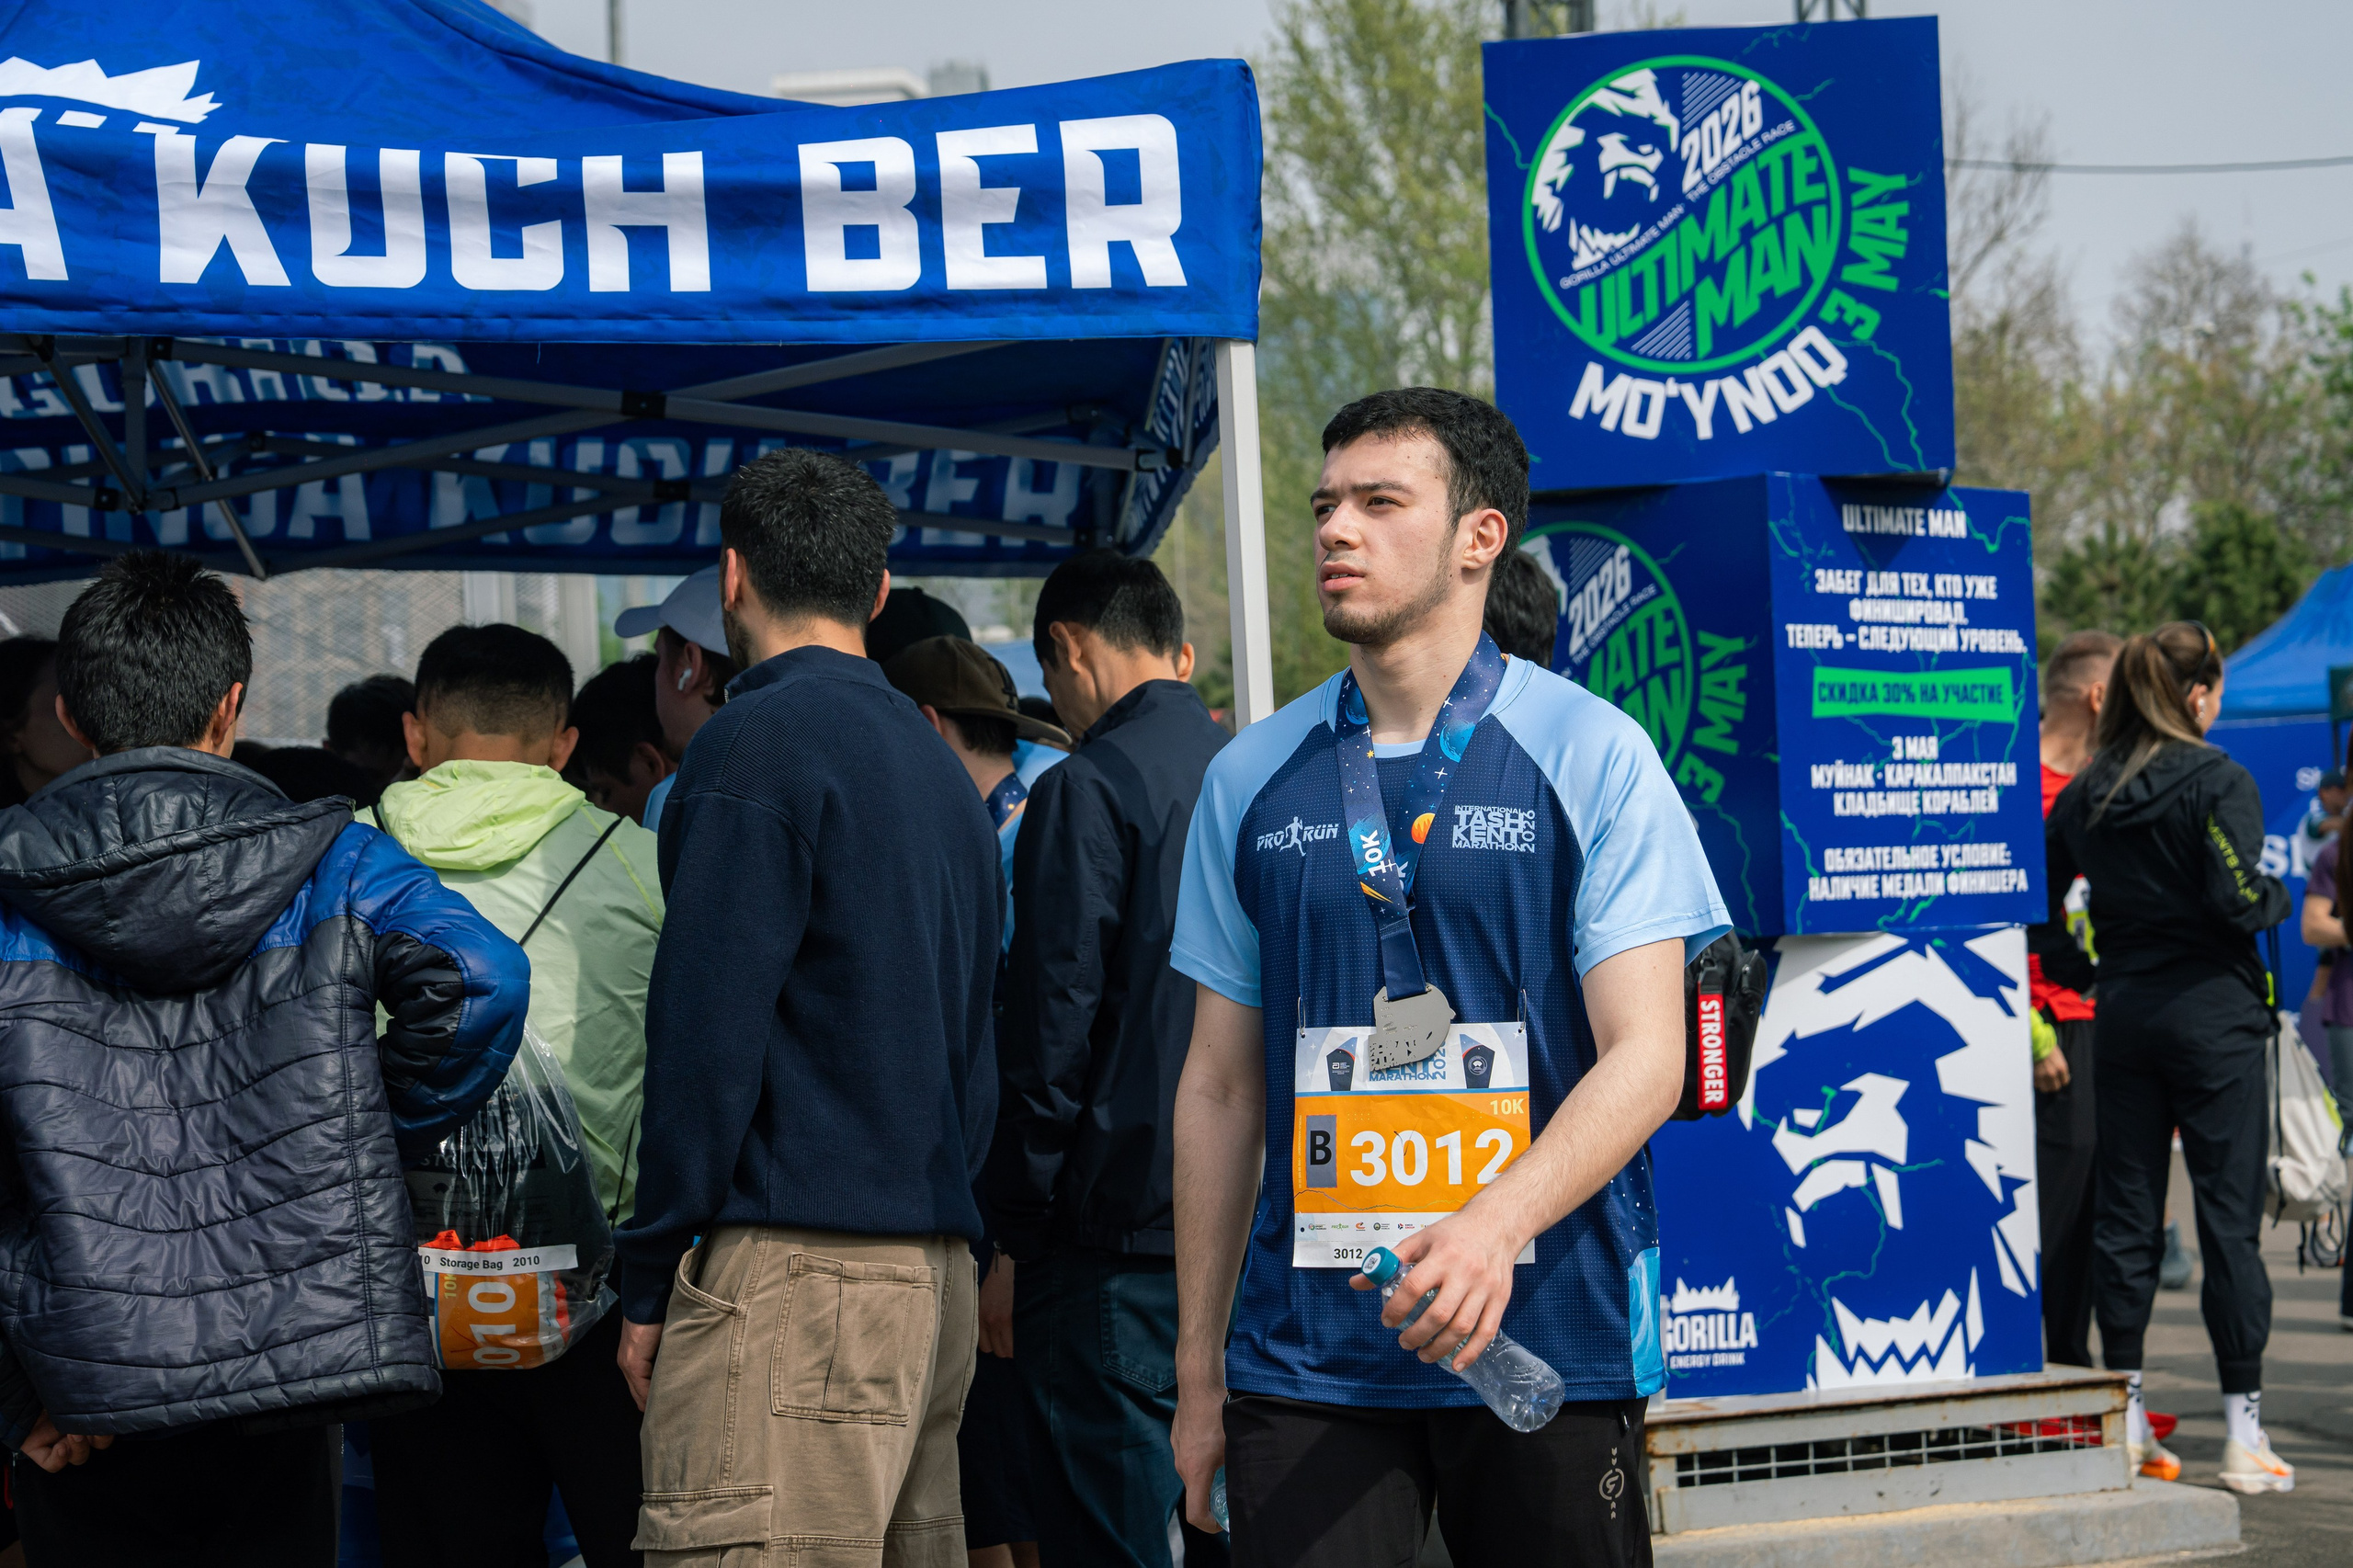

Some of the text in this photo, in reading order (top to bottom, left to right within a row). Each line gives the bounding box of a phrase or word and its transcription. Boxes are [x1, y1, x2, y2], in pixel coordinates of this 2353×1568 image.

[1680, 78, 1764, 194] 2026
[153, 133, 711, 293] KUCH
[798, 113, 1188, 292] BER
[1560, 259, 1609, 290] GORILLA
[1760, 119, 1796, 145] RACE
[1579, 140, 1827, 347] ULTIMATE
[1818, 166, 1909, 340] 3 MAY
[1695, 204, 1829, 359] MAN
[1842, 504, 1967, 539] ULTIMATE MAN
[1814, 568, 1998, 599] ЗАБЕГ ДЛЯ ТЕХ, КТО УЖЕ
[1568, 544, 1632, 657] 2026
[1848, 597, 1969, 625] ФИНИШИРОВАЛ.
[1785, 623, 1844, 650] ТЕПЕРЬ
[1858, 624, 1959, 653] СЛЕДУЮЩИЙ
[1960, 628, 2028, 653] УРОВЕНЬ.
[1818, 681, 2004, 705] СКИДКА 30% НА УЧАСТИЕ
[1675, 630, 1746, 803] 3 MAY
[1904, 735, 1938, 760] МАЯ
[1811, 759, 1876, 789] МУЙНАК
[1884, 762, 2018, 788] КАРАКАЛПАКСТАН
[1455, 804, 1522, 814] INTERNATIONAL
[1834, 785, 1999, 818] КЛАДБИЩЕ КОРАБЛЕЙ
[1256, 824, 1339, 851] PRO RUN
[1452, 824, 1522, 844] KENT
[1454, 810, 1524, 833] TASH
[1360, 829, 1386, 877] 10K
[1452, 840, 1526, 852] MARATHON
[1824, 842, 2012, 872] ОБЯЗАТЕЛЬНОЕ УСЛОВИЕ:
[1808, 868, 2029, 902] НАЛИЧИЕ МЕДАЛИ ФИНИШЕРА
[1434, 1040, 1446, 1080] 202
[1700, 999, 1724, 1105] STRONGER
[1370, 1071, 1436, 1082] MARATHON
[1490, 1098, 1525, 1115] 10K
[1310, 1130, 1332, 1165] B
[1349, 1128, 1514, 1187] 3012
[439, 1256, 479, 1270] Storage
[483, 1259, 503, 1270] Bag
[512, 1256, 540, 1267] 2010
[1334, 1248, 1362, 1259] 3012
[468, 1281, 521, 1369] 010
[1669, 1351, 1745, 1369] ENERGY DRINK
